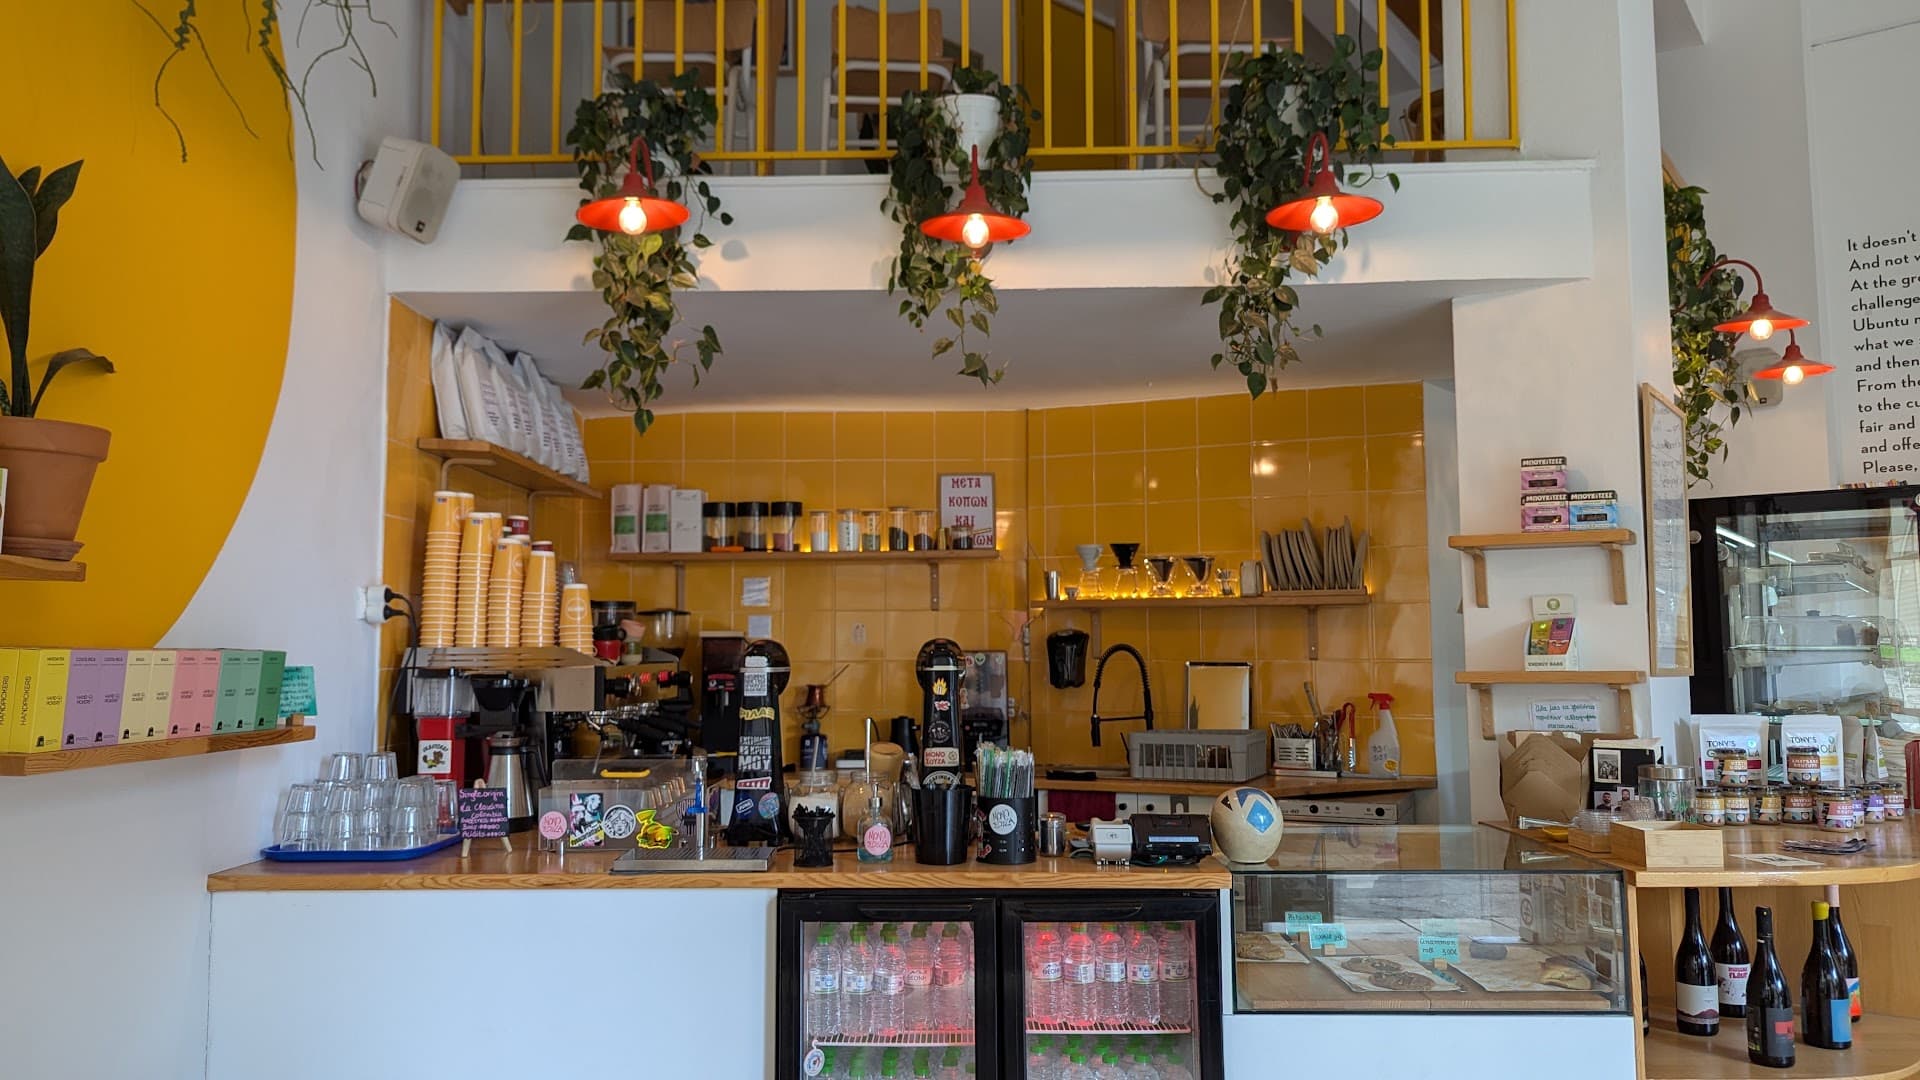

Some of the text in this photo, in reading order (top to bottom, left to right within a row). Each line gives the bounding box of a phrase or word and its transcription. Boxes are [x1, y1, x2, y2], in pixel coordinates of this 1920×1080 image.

[1848, 230, 1917, 251] It doesn't
[1849, 254, 1880, 271] And
[1885, 255, 1909, 266] not
[1850, 279, 1868, 291] At
[1873, 274, 1897, 288] the
[1851, 294, 1920, 311] challenge
[1853, 317, 1909, 331] Ubuntu
[1854, 337, 1914, 351] what we
[1855, 354, 1920, 372] and then
[1857, 379, 1896, 392] From
[1858, 403, 1872, 413] to
[1877, 396, 1901, 411] the
[1859, 415, 1915, 433] fair and
[1861, 438, 1887, 454] and
[1863, 459, 1918, 474] Please,
